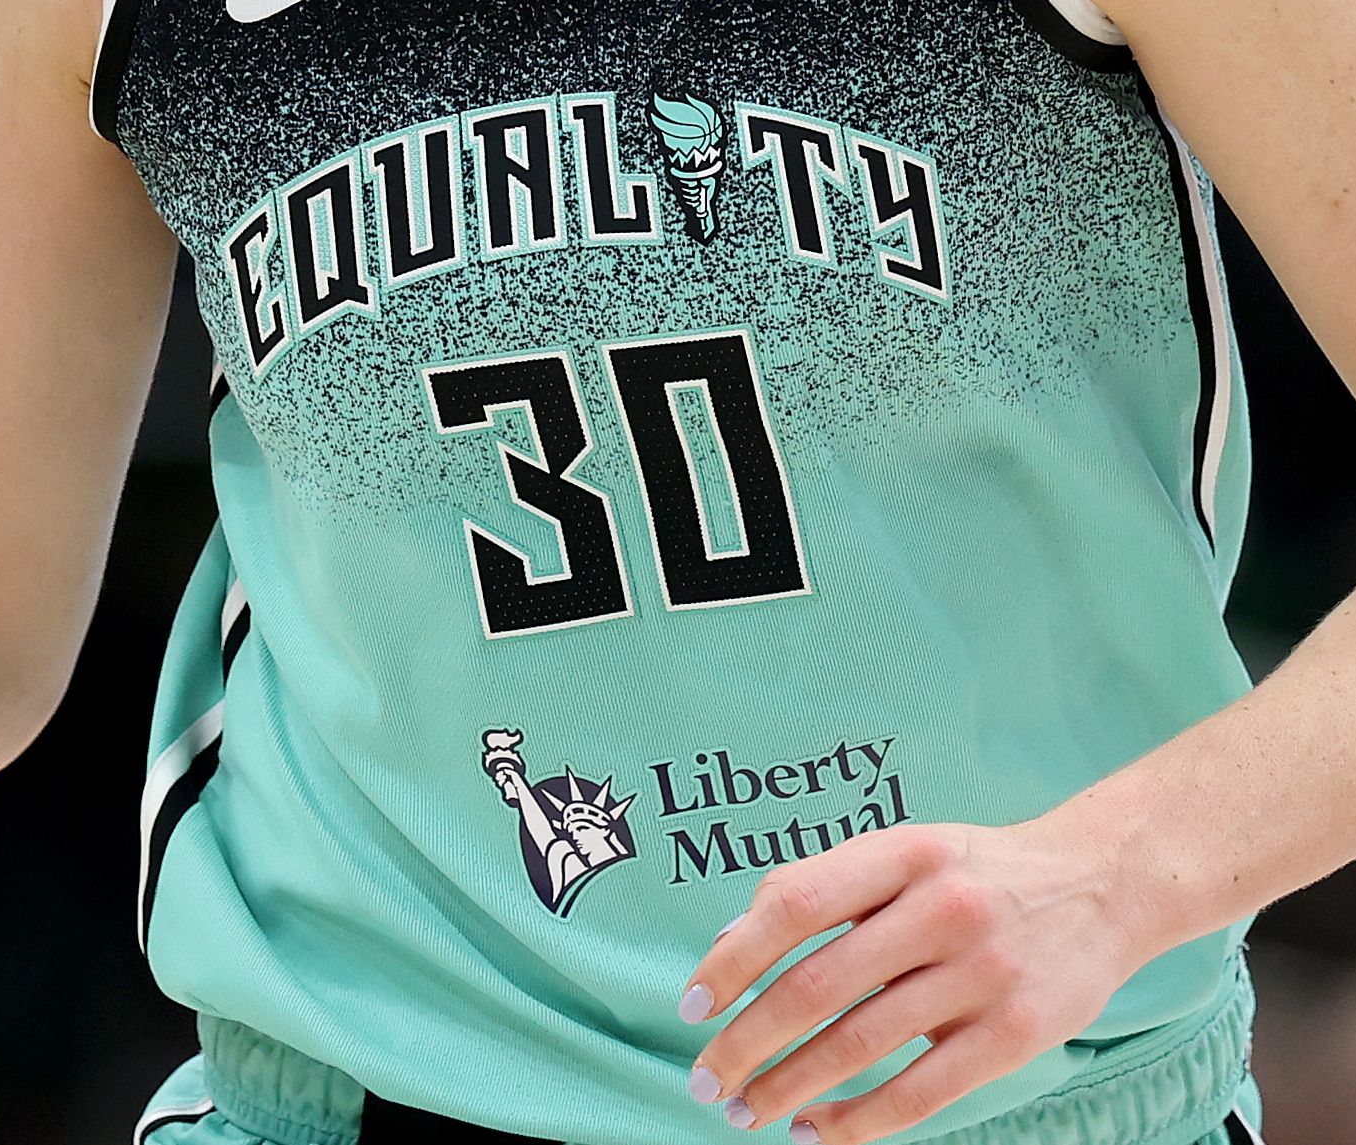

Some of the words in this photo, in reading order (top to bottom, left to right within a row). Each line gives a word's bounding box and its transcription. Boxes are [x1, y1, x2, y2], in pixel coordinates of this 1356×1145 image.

[422, 328, 811, 640] 30
[649, 737, 896, 818] Liberty
[666, 774, 911, 885] Mutual
